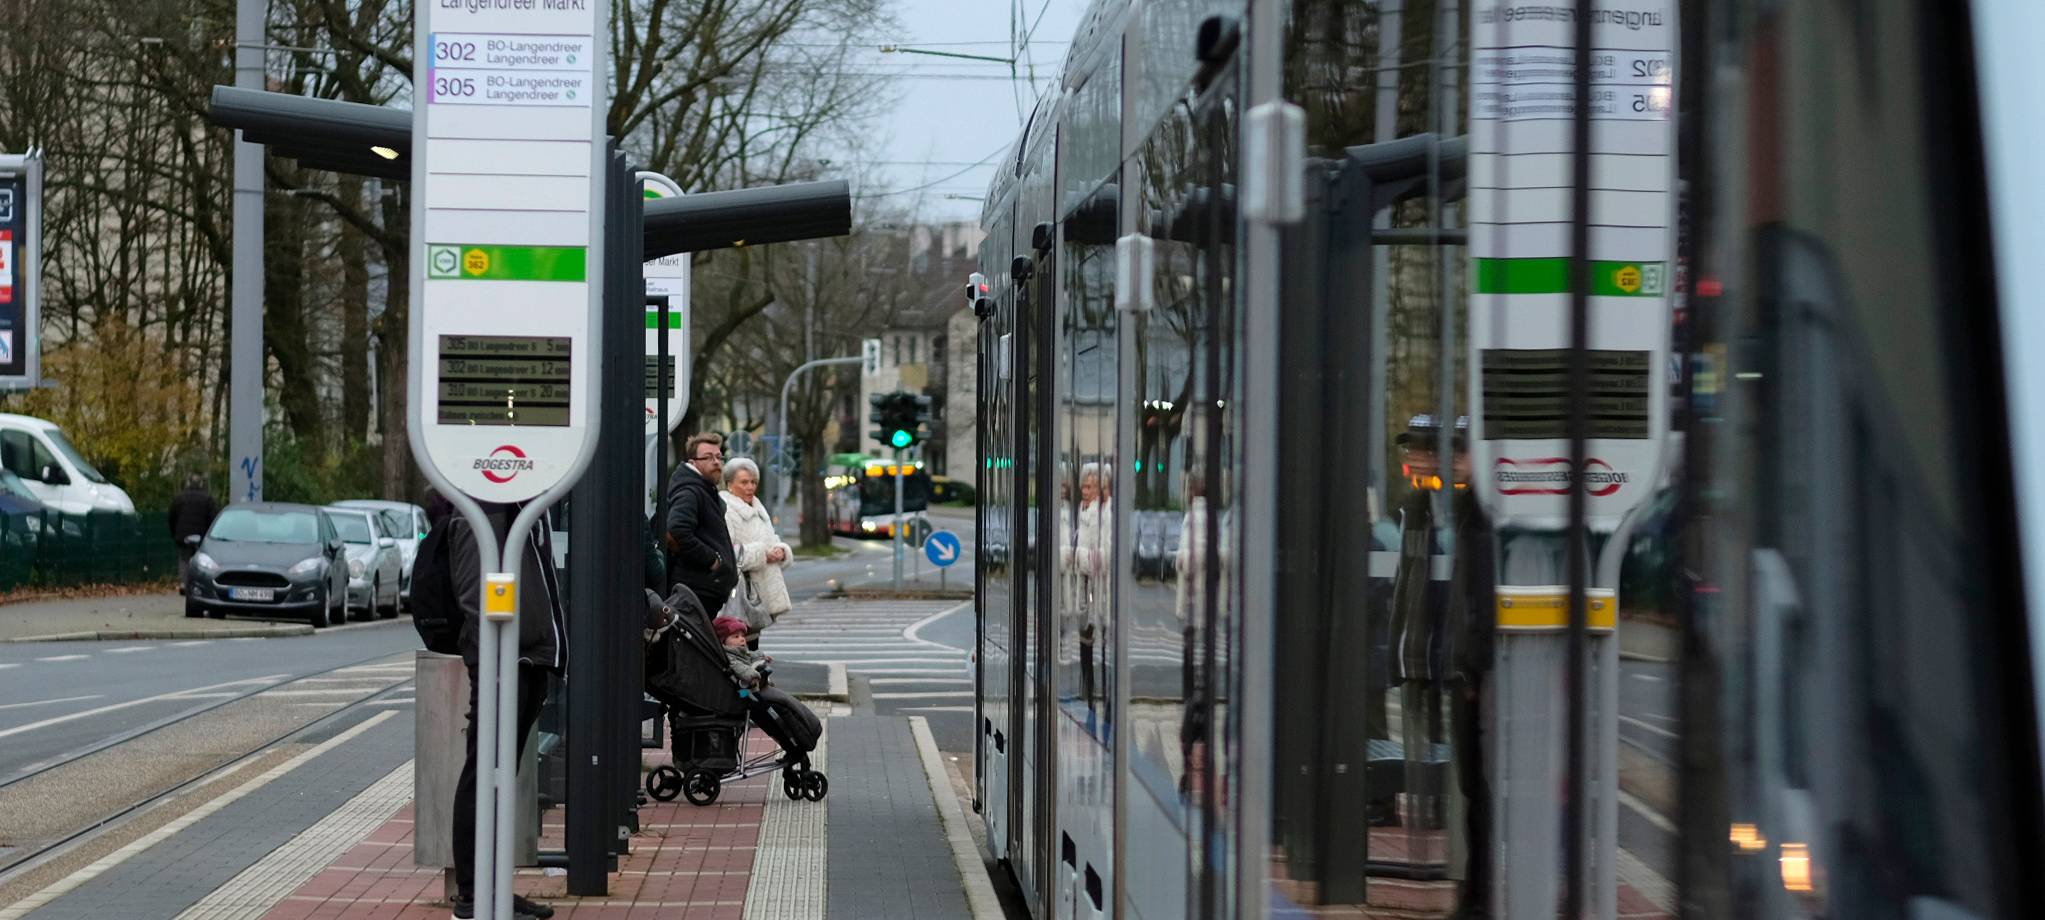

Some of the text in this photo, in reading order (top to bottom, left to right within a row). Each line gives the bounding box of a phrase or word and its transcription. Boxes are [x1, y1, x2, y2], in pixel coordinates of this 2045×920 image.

[441, 0, 585, 13] Langendreer Markt
[436, 42, 476, 61] 302
[487, 40, 583, 54] BO-Langendreer
[487, 54, 559, 65] Langendreer
[436, 78, 475, 96] 305
[487, 76, 581, 90] BO-Langendreer
[487, 90, 559, 102] Langendreer
[447, 336, 465, 350] 305
[547, 339, 553, 352] 5
[447, 360, 465, 374] 302
[541, 362, 554, 375] 12
[540, 385, 554, 398] 20
[473, 459, 534, 470] BOGESTRA
